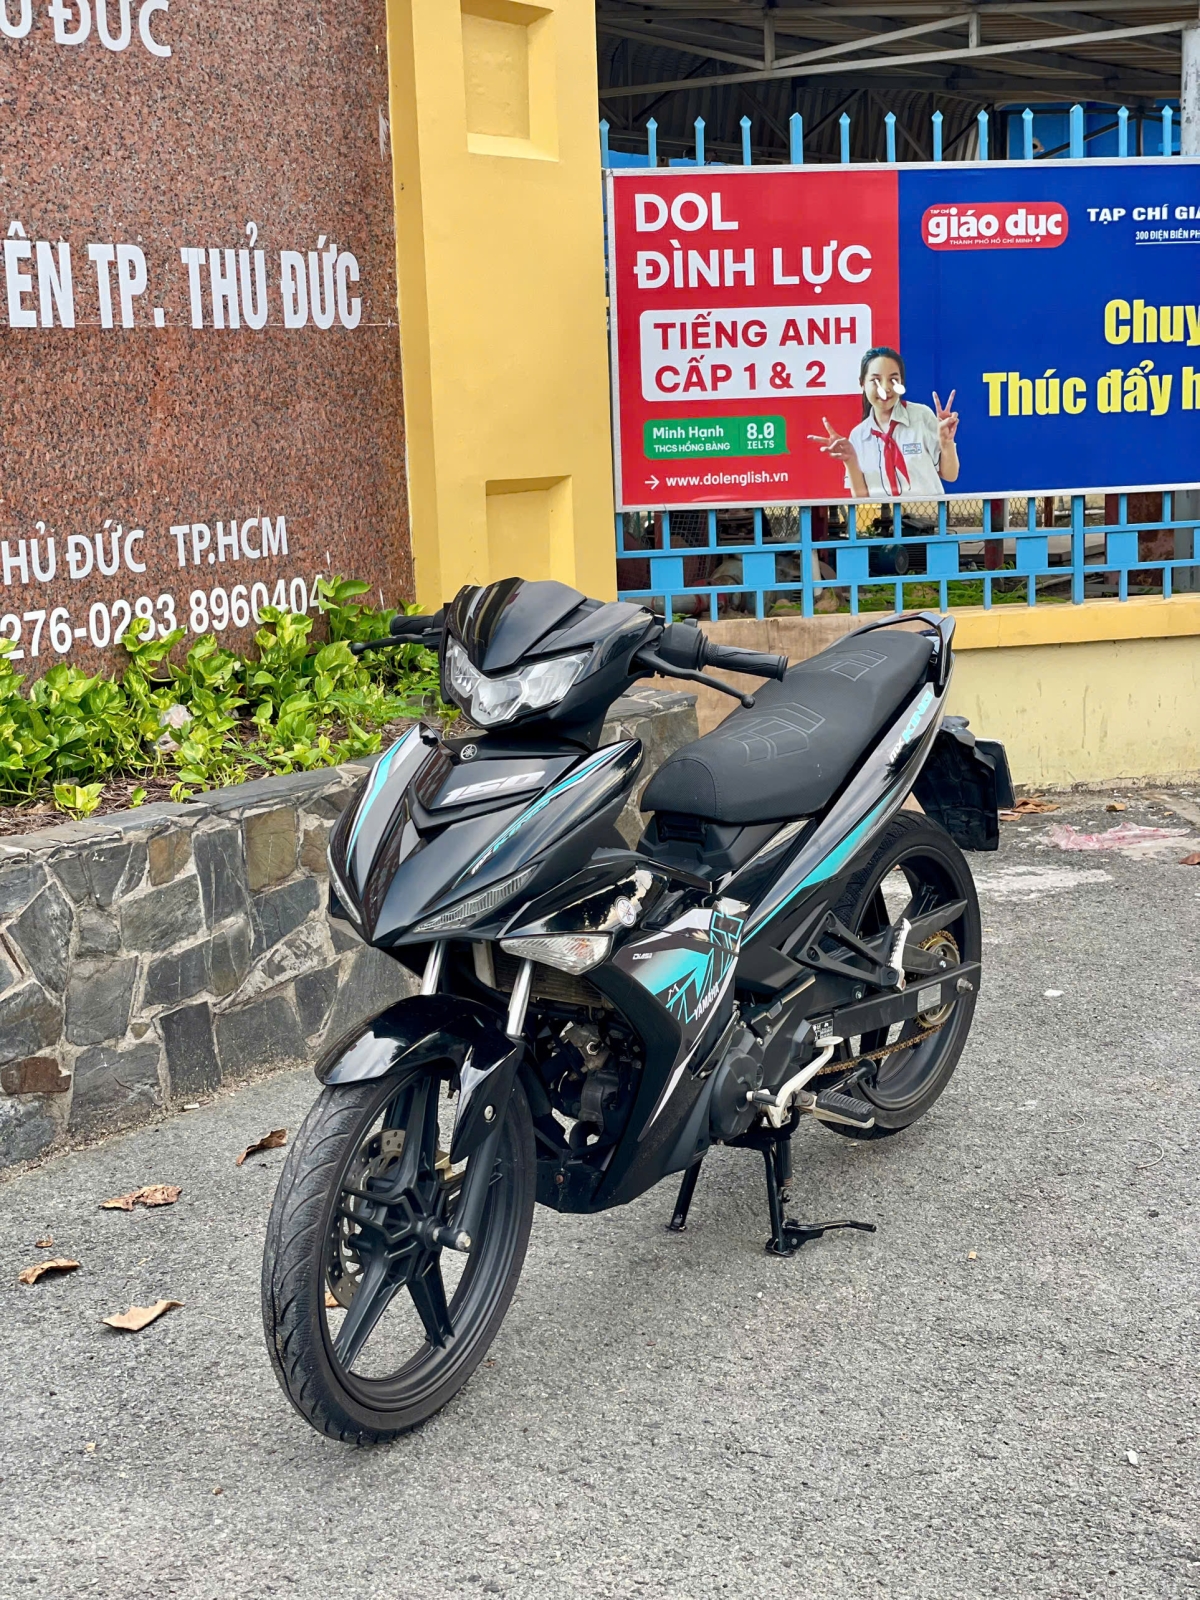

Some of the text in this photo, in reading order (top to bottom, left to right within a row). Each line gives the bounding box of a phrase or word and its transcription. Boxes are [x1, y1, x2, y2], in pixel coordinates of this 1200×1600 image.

[634, 192, 739, 232] DOL
[928, 207, 1062, 244] giáo dục
[1087, 207, 1126, 225] TẠP
[1132, 204, 1170, 221] CHÍ
[1135, 231, 1149, 240] 300
[4, 221, 362, 330] ÊN TP. THỦ ĐỨC
[634, 239, 872, 294] ĐÌNH LỰC
[653, 311, 857, 350] TIẾNG ANH
[655, 355, 826, 393] CẤP 1 & 2
[983, 369, 1087, 416] Thúc
[1097, 360, 1173, 415] đẩy
[653, 425, 724, 441] Minh Hạnh
[654, 441, 731, 453] THCS HỒNG BÀNG
[747, 422, 775, 440] 8.0
[747, 440, 775, 449] IELTS
[666, 470, 789, 488] www.dolenglish.vn
[1, 515, 289, 586] HỦ ĐỨC TP.HCM
[440, 770, 546, 806] 150
